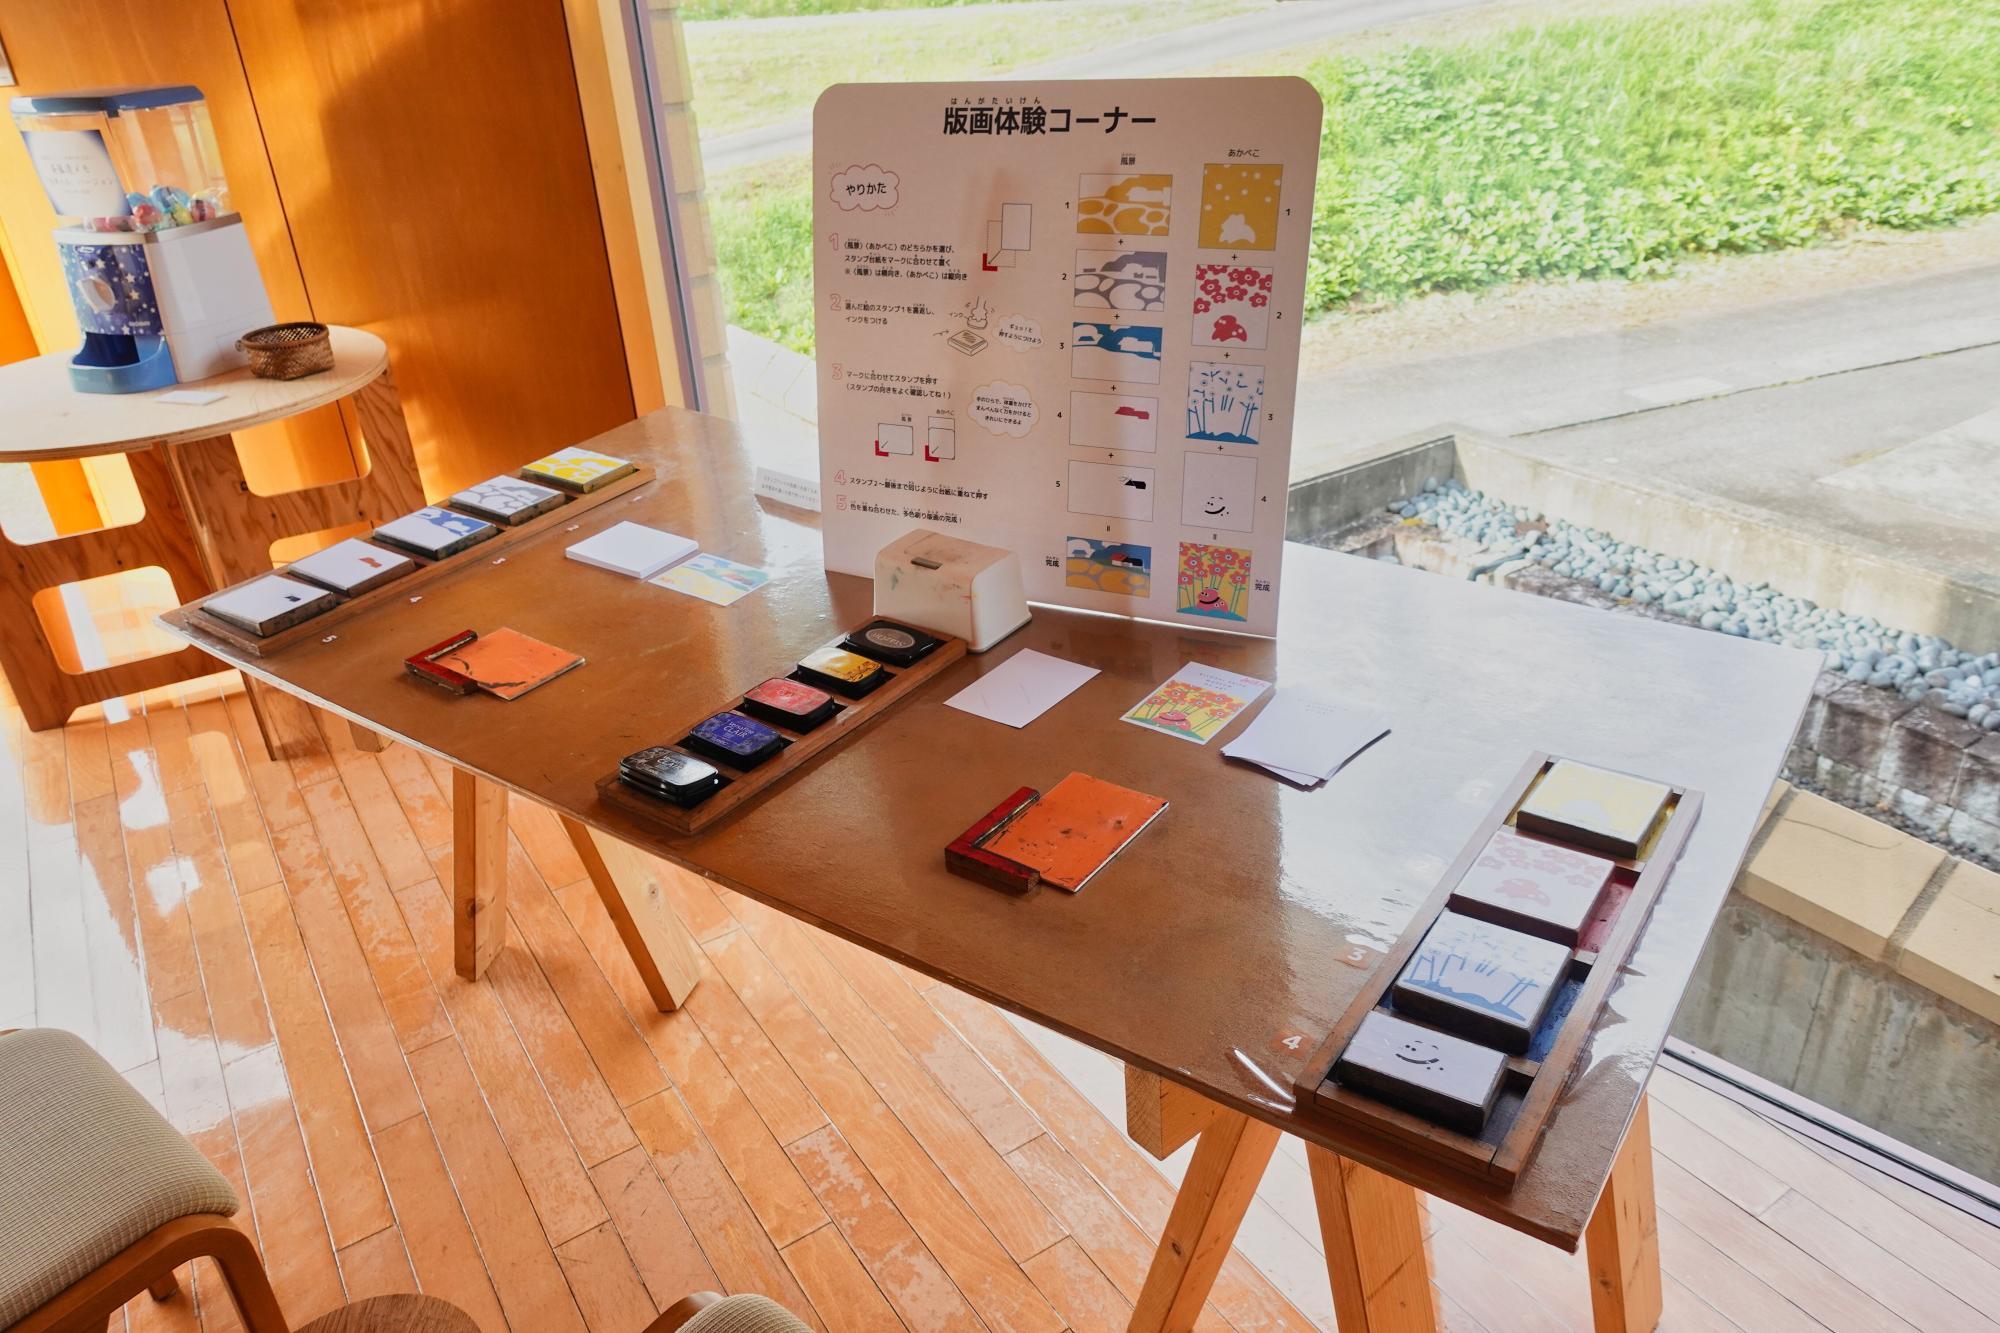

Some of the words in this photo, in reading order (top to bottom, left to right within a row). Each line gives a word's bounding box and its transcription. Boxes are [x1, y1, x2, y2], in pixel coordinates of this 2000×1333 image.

[950, 97, 1041, 105] はんがたいけん
[943, 106, 1156, 135] 版画体験コーナー
[1228, 149, 1260, 158] あかべこ
[1120, 156, 1136, 166] 風景
[845, 182, 888, 196] やりかた
[1064, 201, 1070, 209] 1
[1285, 208, 1291, 216] 1
[829, 233, 839, 251] 1
[830, 293, 842, 311] 2
[845, 316, 888, 325] インクをつける
[831, 363, 843, 380] 3
[834, 469, 846, 486] 4
[836, 494, 848, 511] 5
[1347, 947, 1368, 961] 3
[1281, 1035, 1303, 1050] 4
